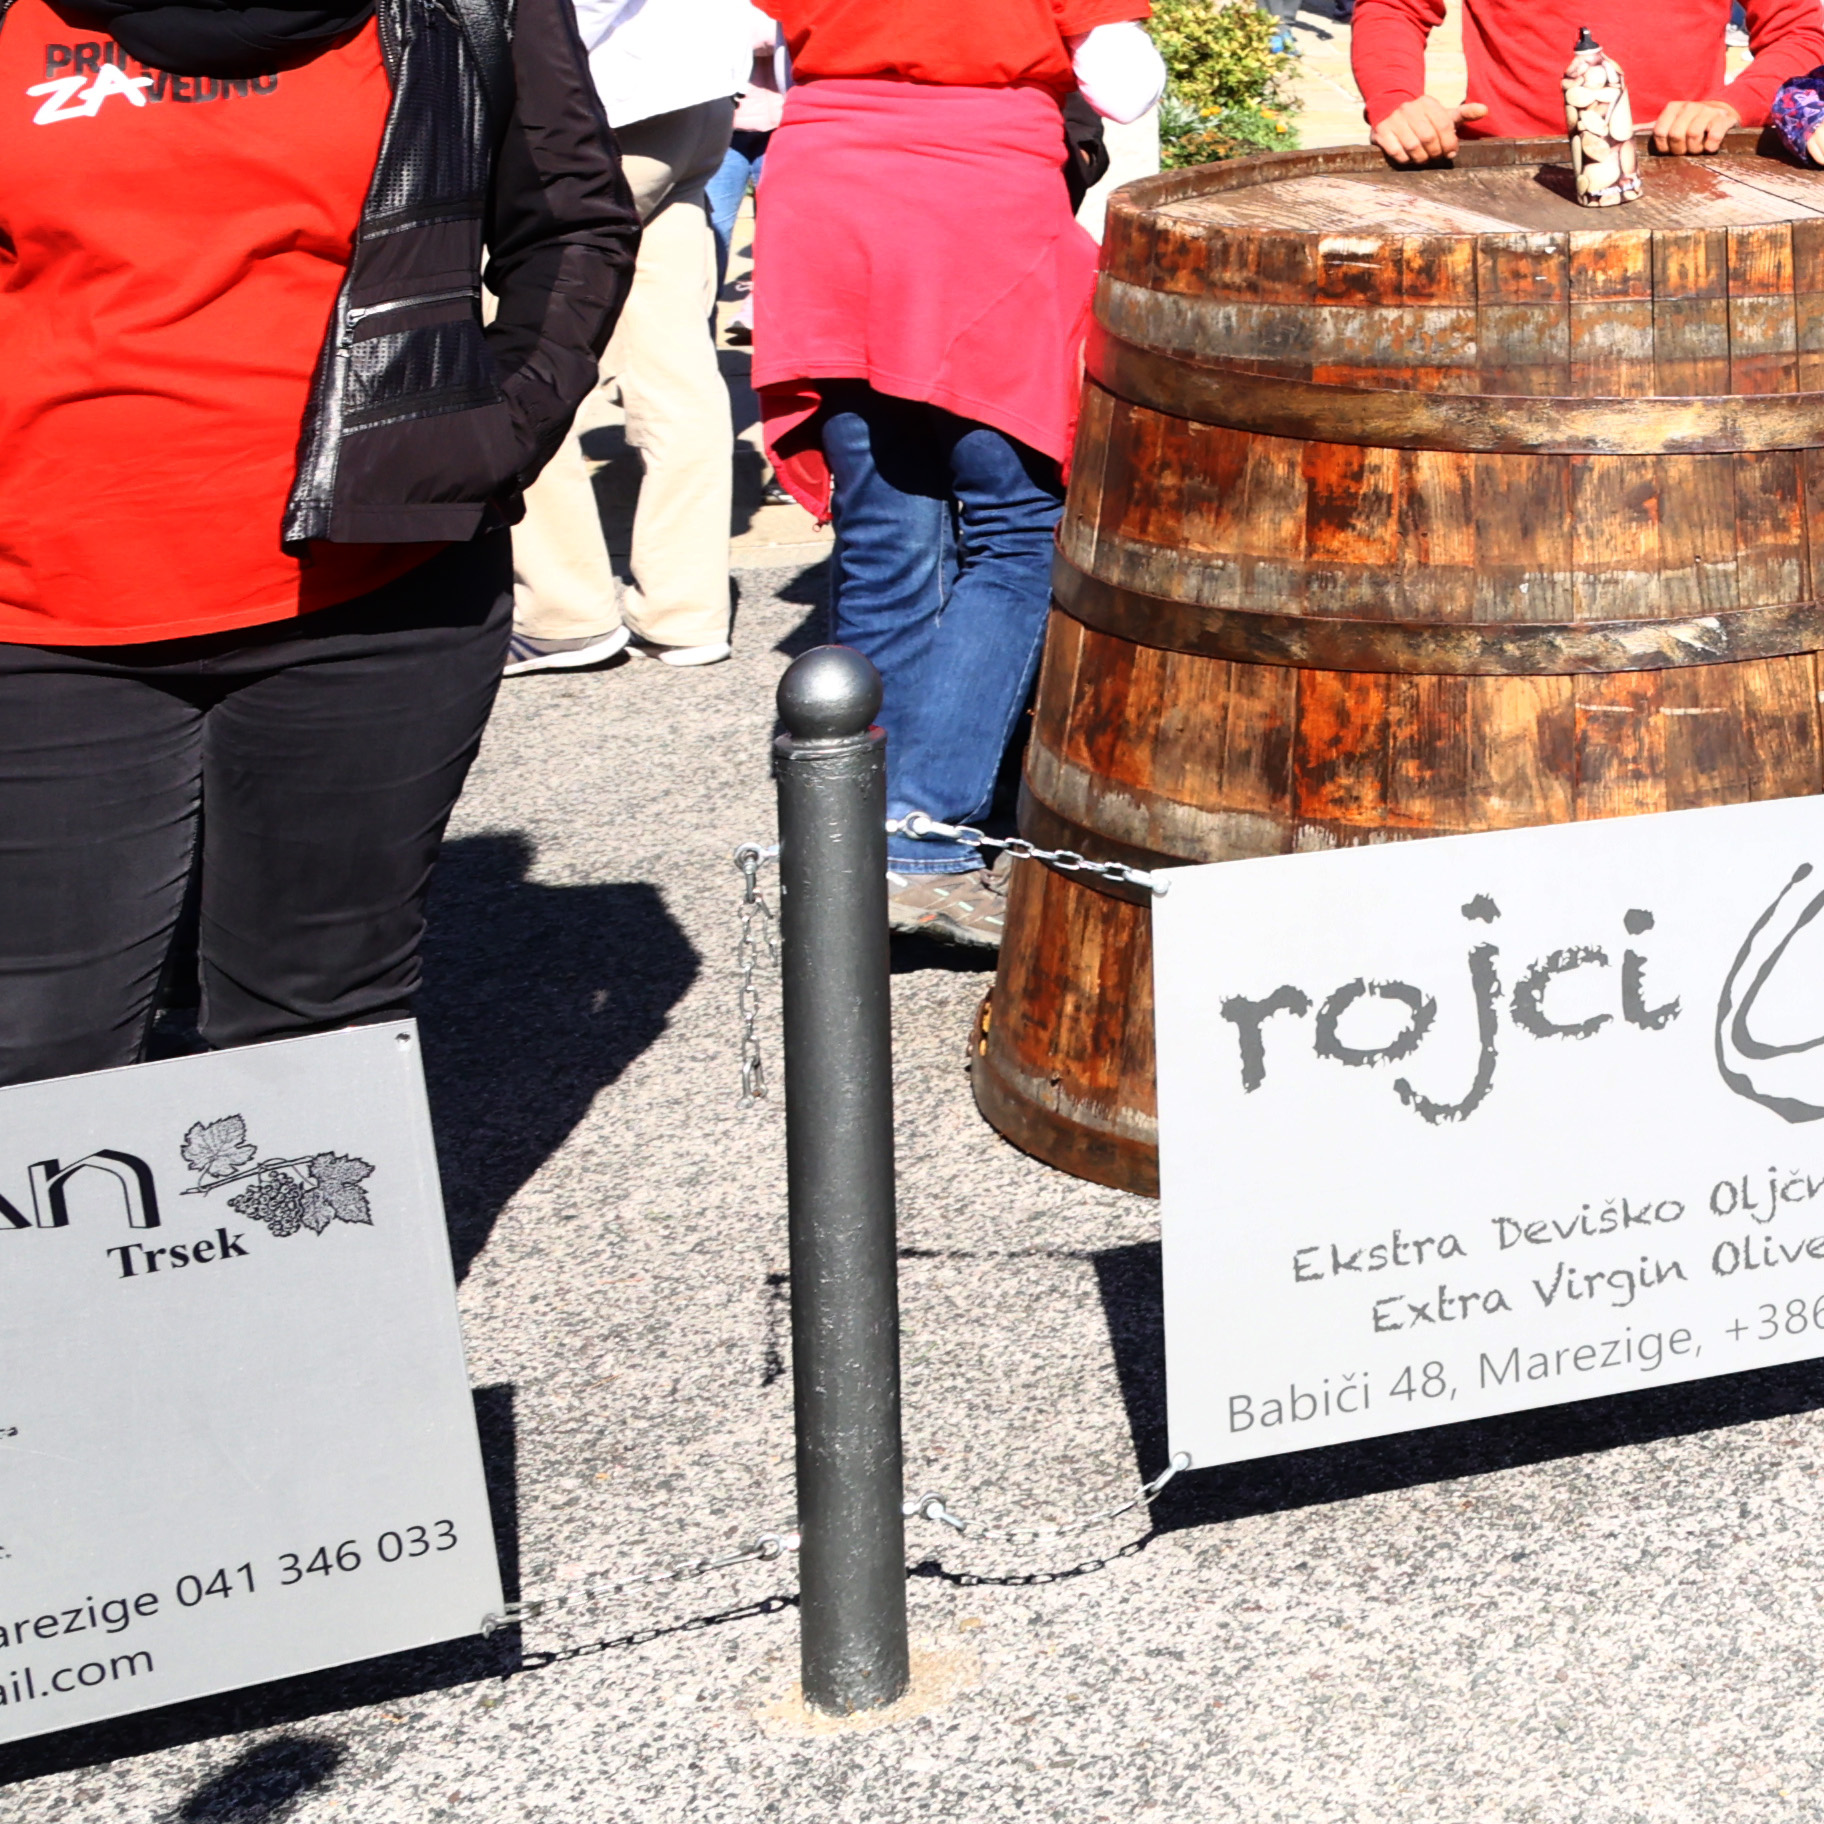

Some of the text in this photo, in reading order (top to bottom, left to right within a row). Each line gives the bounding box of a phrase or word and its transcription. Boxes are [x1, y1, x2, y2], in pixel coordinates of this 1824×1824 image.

[26, 63, 153, 125] ZA
[1220, 894, 1681, 1126] rojci
[107, 1228, 249, 1278] Trsek
[1293, 1229, 1467, 1282] Ekstra
[1492, 1198, 1685, 1250] Deviško
[1373, 1285, 1512, 1332] Extra
[1532, 1256, 1687, 1307] Virgin
[1229, 1372, 1369, 1432] Babiči
[1390, 1361, 1456, 1401] 48,
[1478, 1320, 1704, 1390] Marezige,
[177, 1563, 254, 1606] 041
[279, 1540, 361, 1585] 346
[378, 1520, 457, 1562] 033
